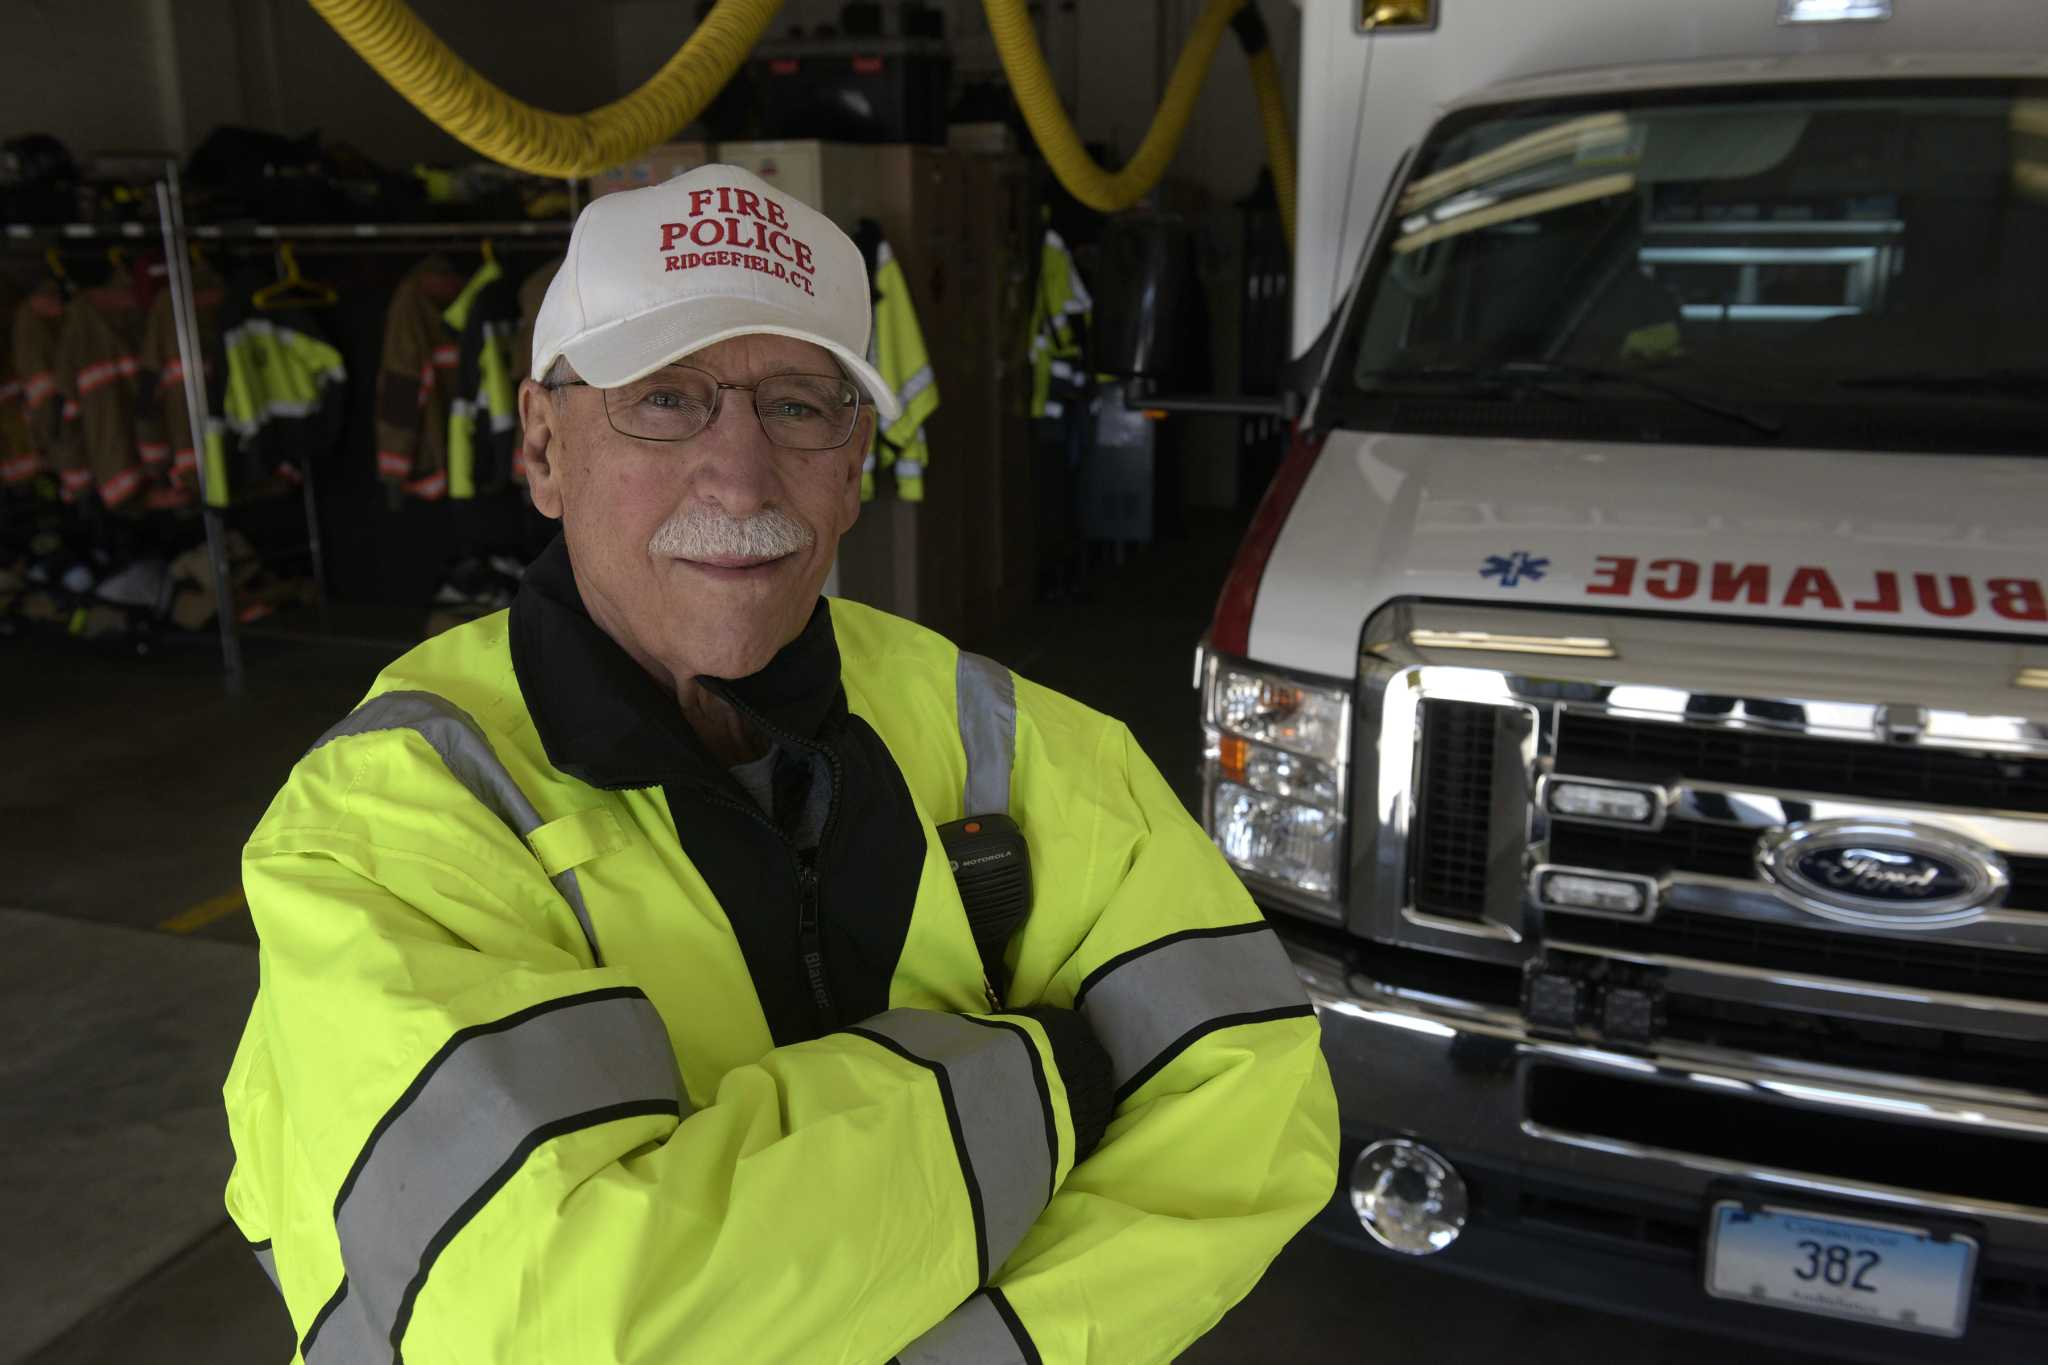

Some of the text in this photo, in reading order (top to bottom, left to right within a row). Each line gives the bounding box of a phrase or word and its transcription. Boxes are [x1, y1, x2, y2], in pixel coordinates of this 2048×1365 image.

[689, 187, 788, 230] FIRE
[660, 218, 815, 275] POLICE
[962, 850, 1012, 867] MOTOROLA
[1820, 848, 1939, 894] Ford
[1794, 1239, 1882, 1293] 382
